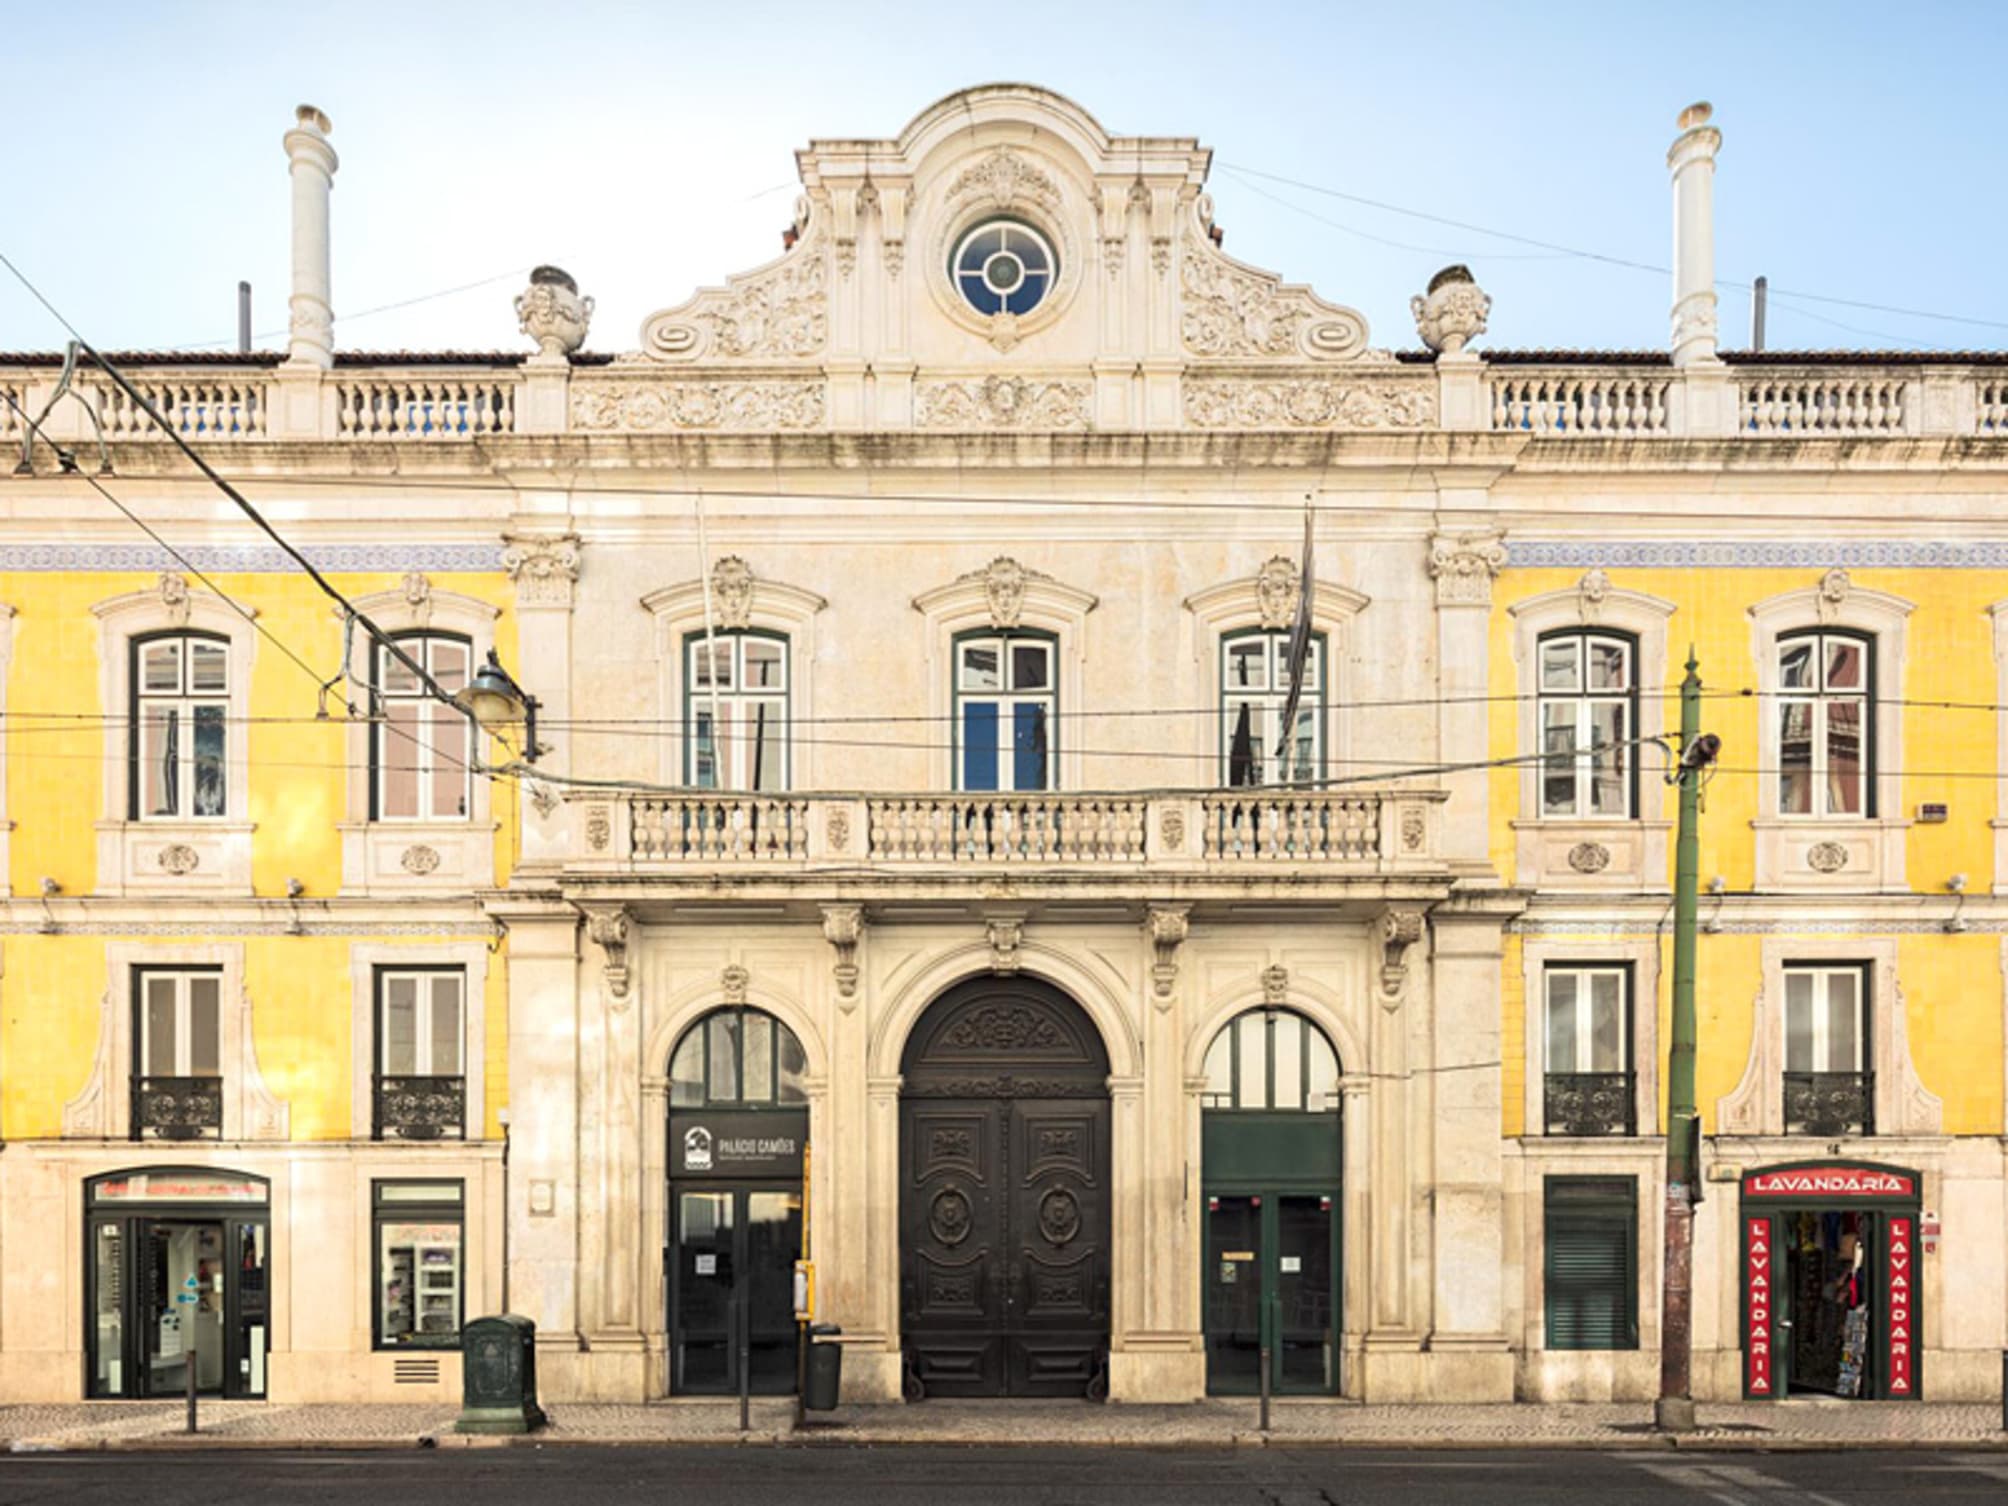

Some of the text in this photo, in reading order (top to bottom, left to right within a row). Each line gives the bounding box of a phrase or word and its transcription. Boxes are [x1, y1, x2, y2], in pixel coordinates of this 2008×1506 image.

[1754, 1176, 1902, 1191] LAVANDARIA
[1751, 1223, 1769, 1389] LAVANDARIA
[1891, 1223, 1908, 1389] LAVANDARIA
